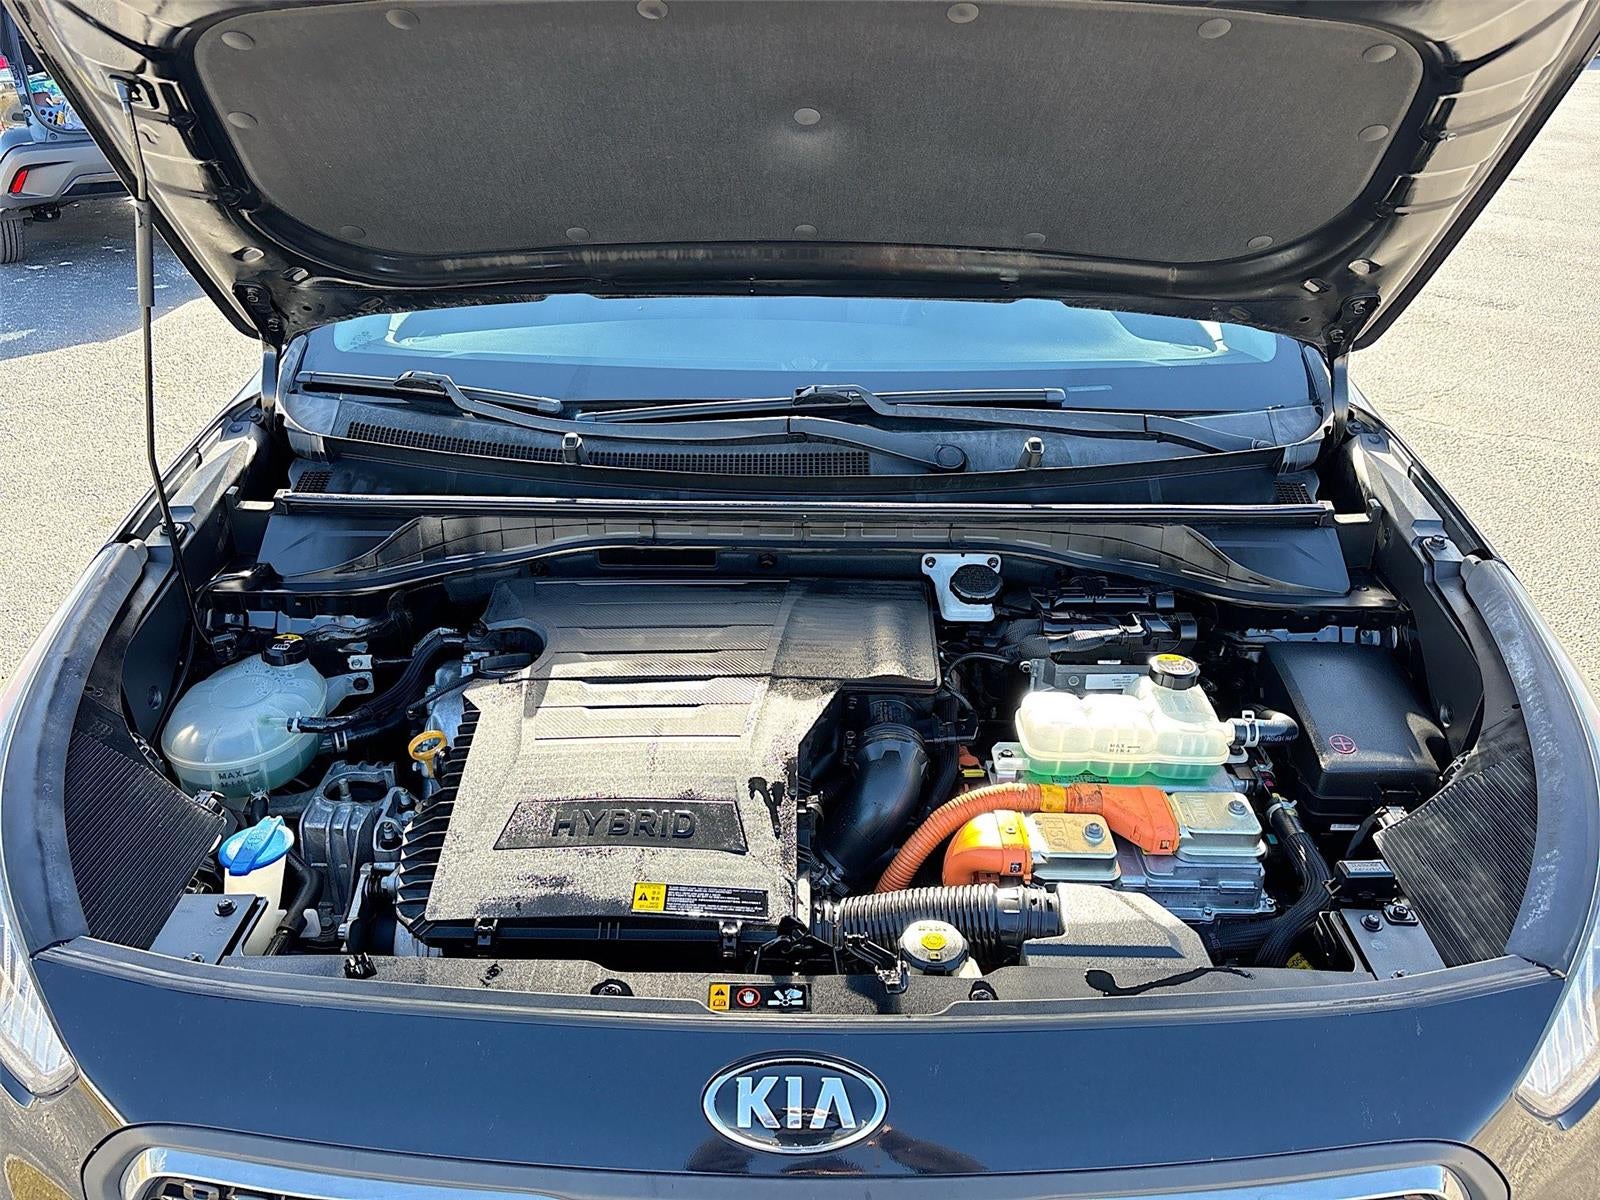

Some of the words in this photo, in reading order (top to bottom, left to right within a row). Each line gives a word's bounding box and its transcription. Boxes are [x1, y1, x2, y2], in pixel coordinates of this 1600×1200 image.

[218, 770, 241, 780] MAX
[551, 807, 697, 839] HYBRID
[735, 1075, 858, 1130] KIA
